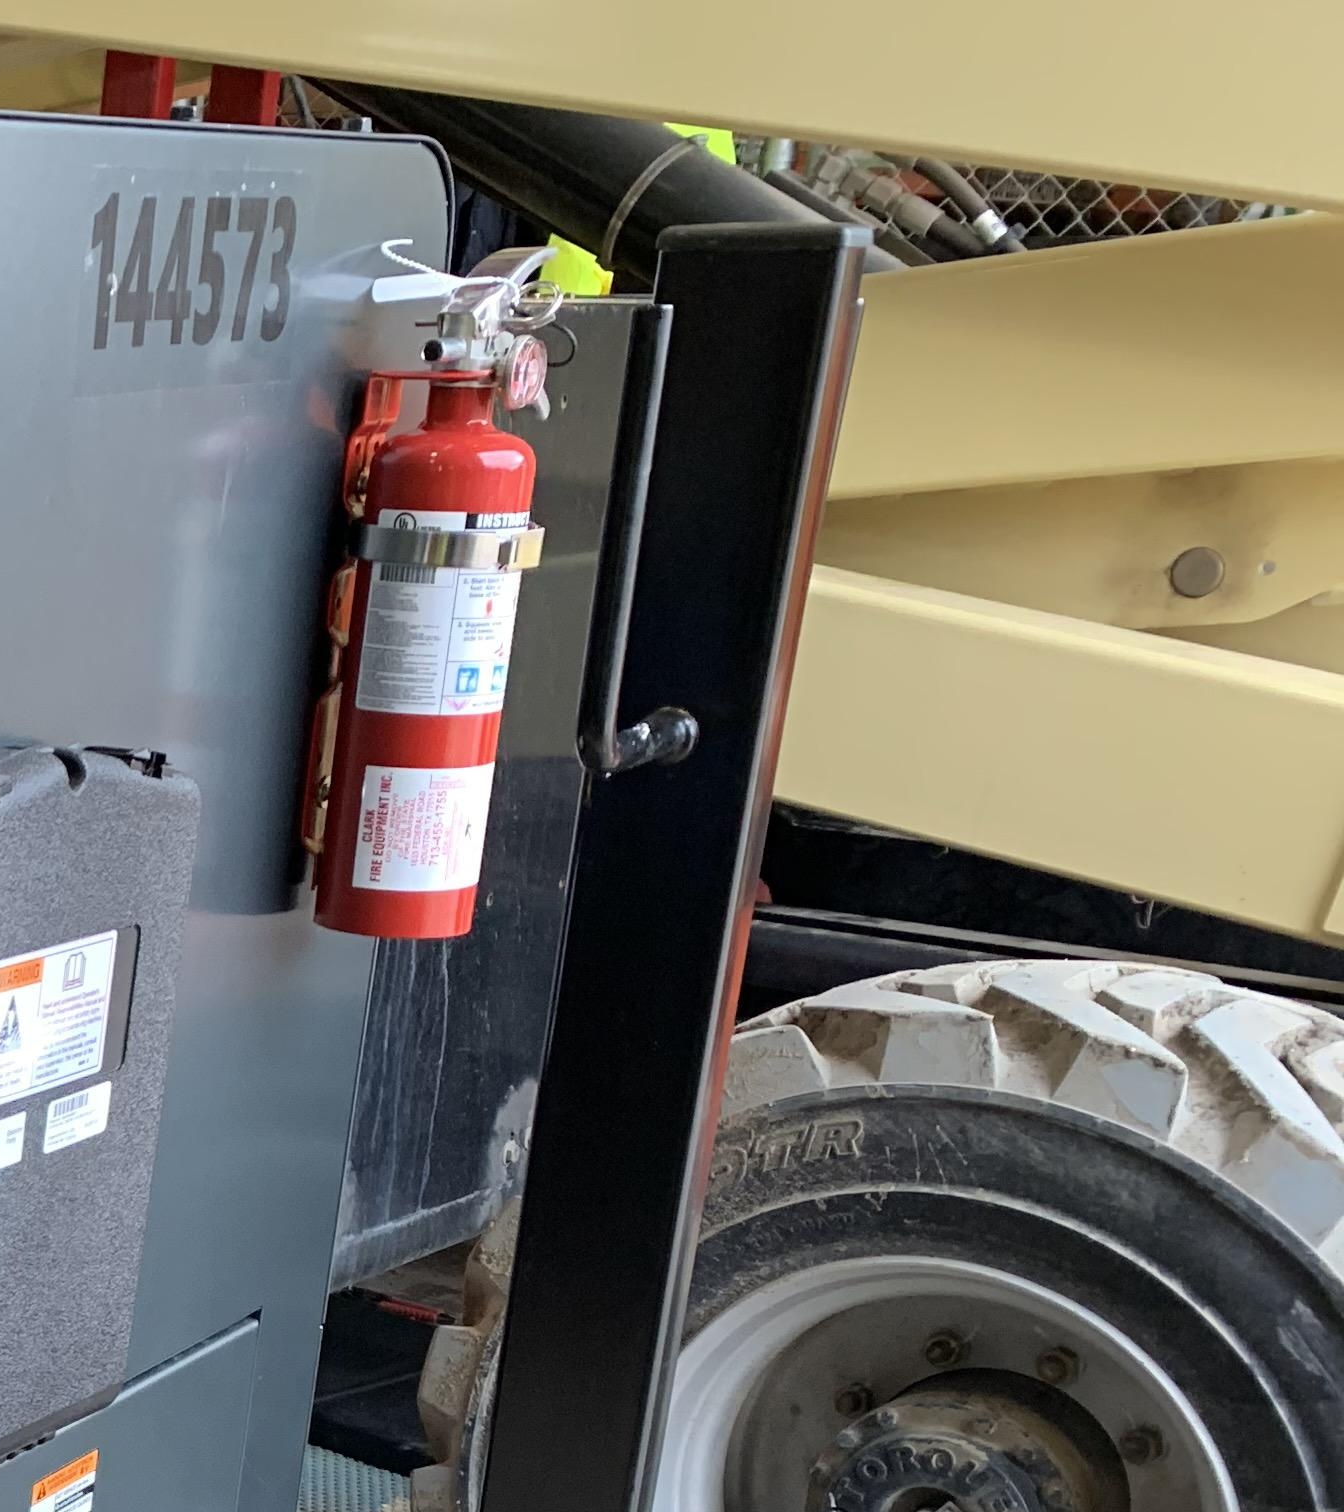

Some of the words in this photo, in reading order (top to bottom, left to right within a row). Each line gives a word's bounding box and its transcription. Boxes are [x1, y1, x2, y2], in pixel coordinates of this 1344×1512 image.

[91, 192, 297, 350] 144573
[362, 809, 375, 842] CLARK
[373, 796, 390, 856] EQUIPMENT
[370, 859, 383, 882] FIRE
